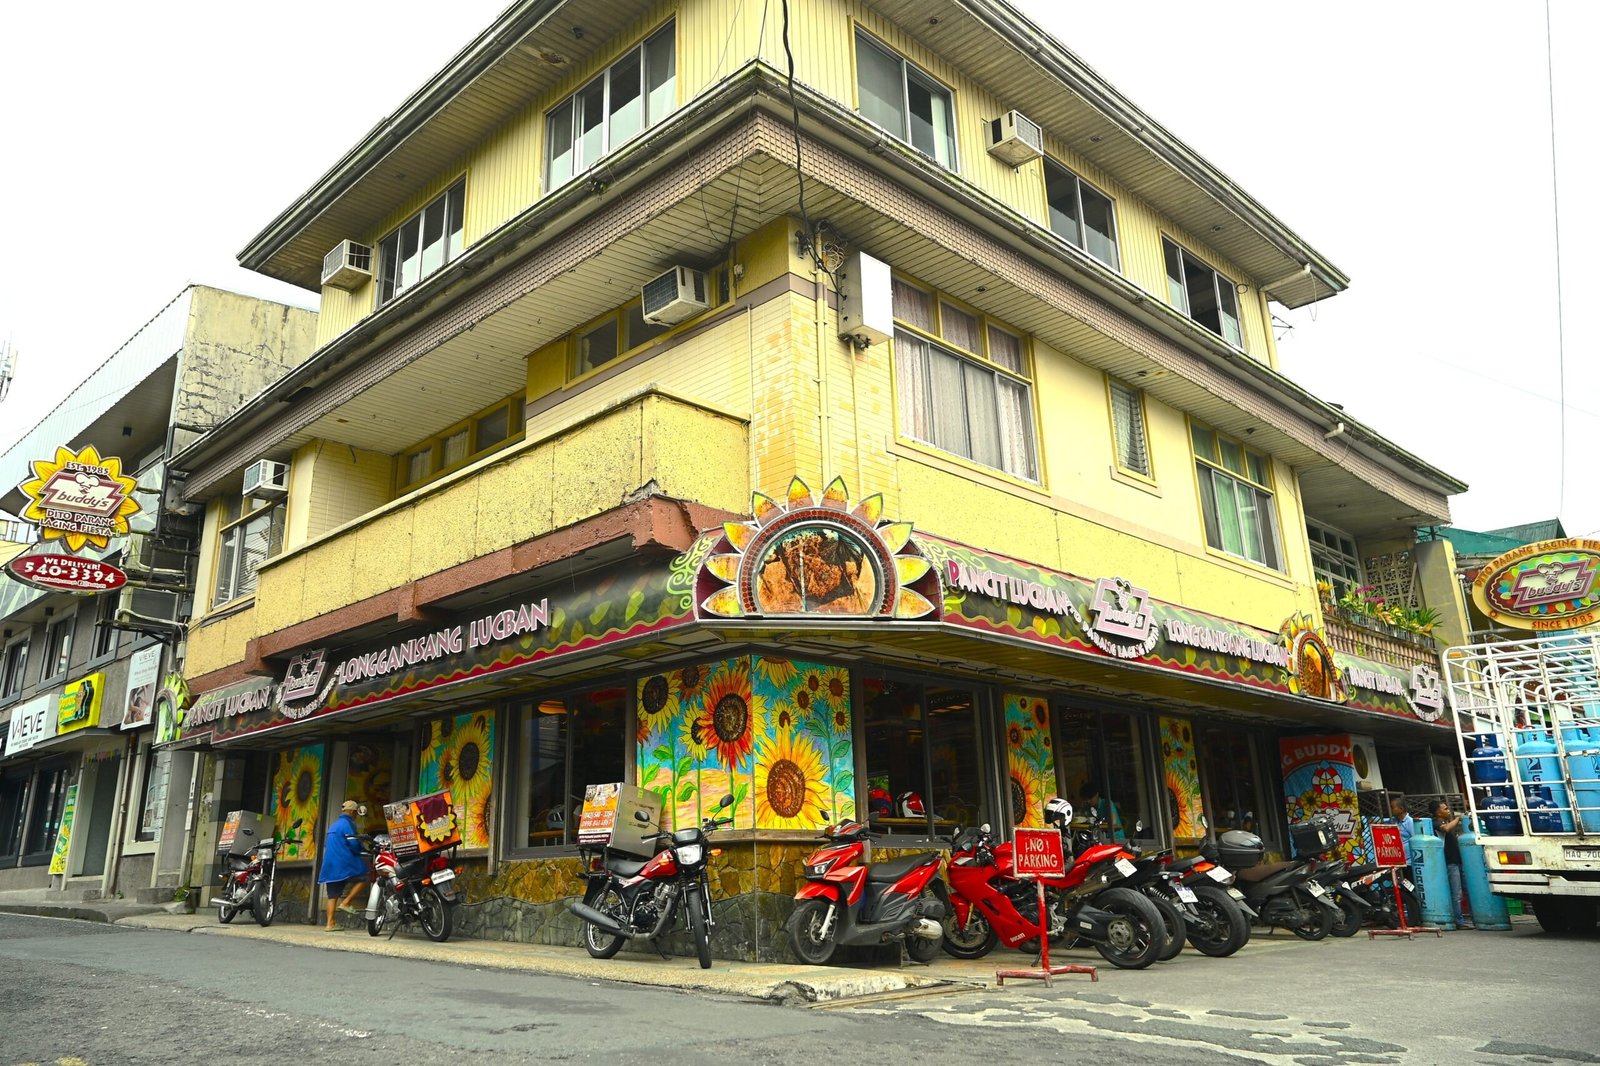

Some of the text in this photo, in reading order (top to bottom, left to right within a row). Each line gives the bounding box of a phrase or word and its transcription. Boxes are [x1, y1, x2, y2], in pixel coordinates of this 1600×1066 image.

[86, 464, 110, 475] 1985
[56, 490, 110, 508] buddy's
[39, 519, 76, 532] LAGING
[46, 510, 116, 527] DITO PARANG
[1493, 545, 1533, 567] PARANG
[1538, 539, 1577, 551] LAGING
[44, 556, 101, 570] WE DELIVER!
[25, 561, 116, 584] 540-3394
[948, 559, 1073, 617] PANCIT LUCBAN
[1528, 579, 1584, 599] buddy's
[1531, 613, 1594, 630] SINCE 1985
[339, 597, 549, 684] LONGGANISANG LUCBAN
[1166, 618, 1289, 667] LONGGANISANG LUCBAN
[186, 698, 224, 727] PANCIT
[223, 685, 269, 718] LUCBAN
[1029, 838, 1044, 852] NO
[1376, 846, 1402, 859] PARKING
[1018, 853, 1058, 868] PARKING
